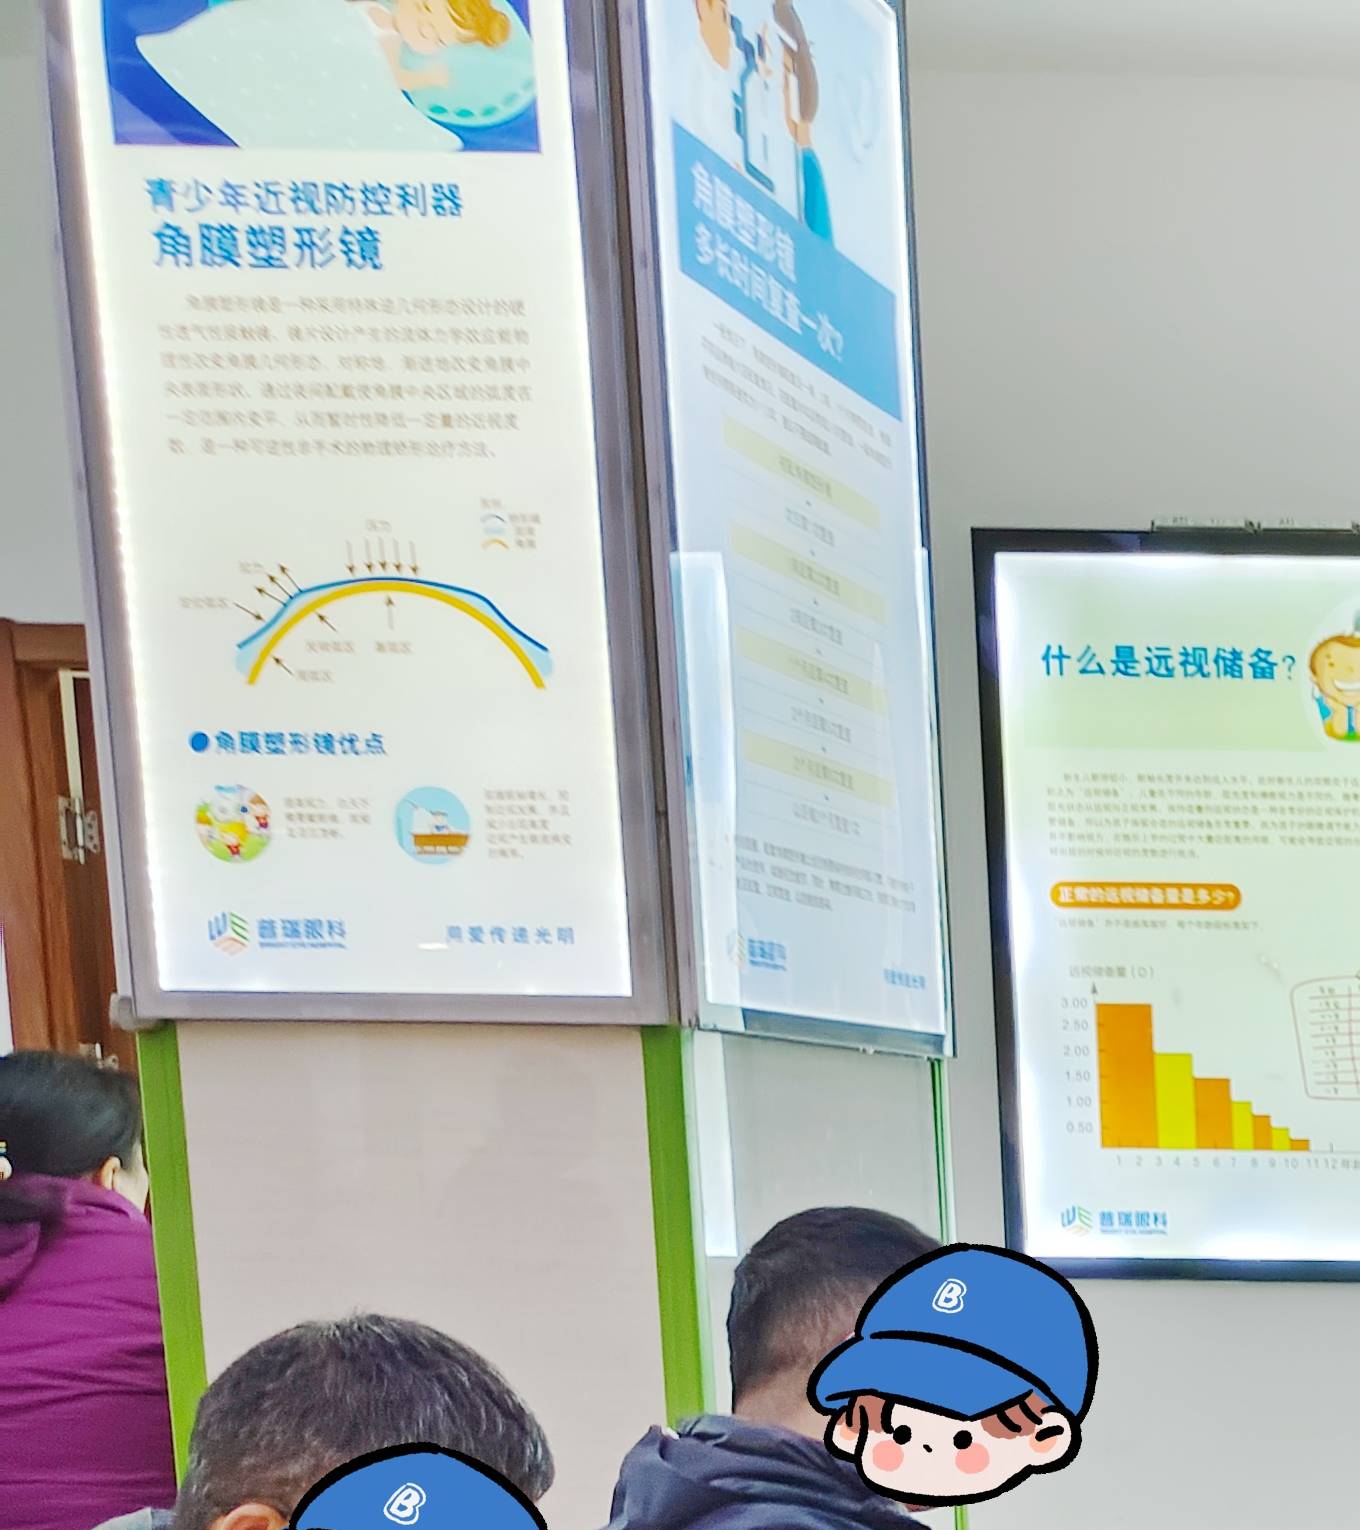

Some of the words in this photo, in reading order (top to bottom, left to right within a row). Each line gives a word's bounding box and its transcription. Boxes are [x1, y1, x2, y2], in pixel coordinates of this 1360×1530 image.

[143, 177, 464, 218] 青少年近视防控利器
[153, 222, 383, 271] 角膜塑形镜
[1041, 643, 1297, 682] 什么是远视储备？
[213, 730, 388, 757] 角膜塑形镜优点
[257, 917, 347, 941] 普瑞眼科
